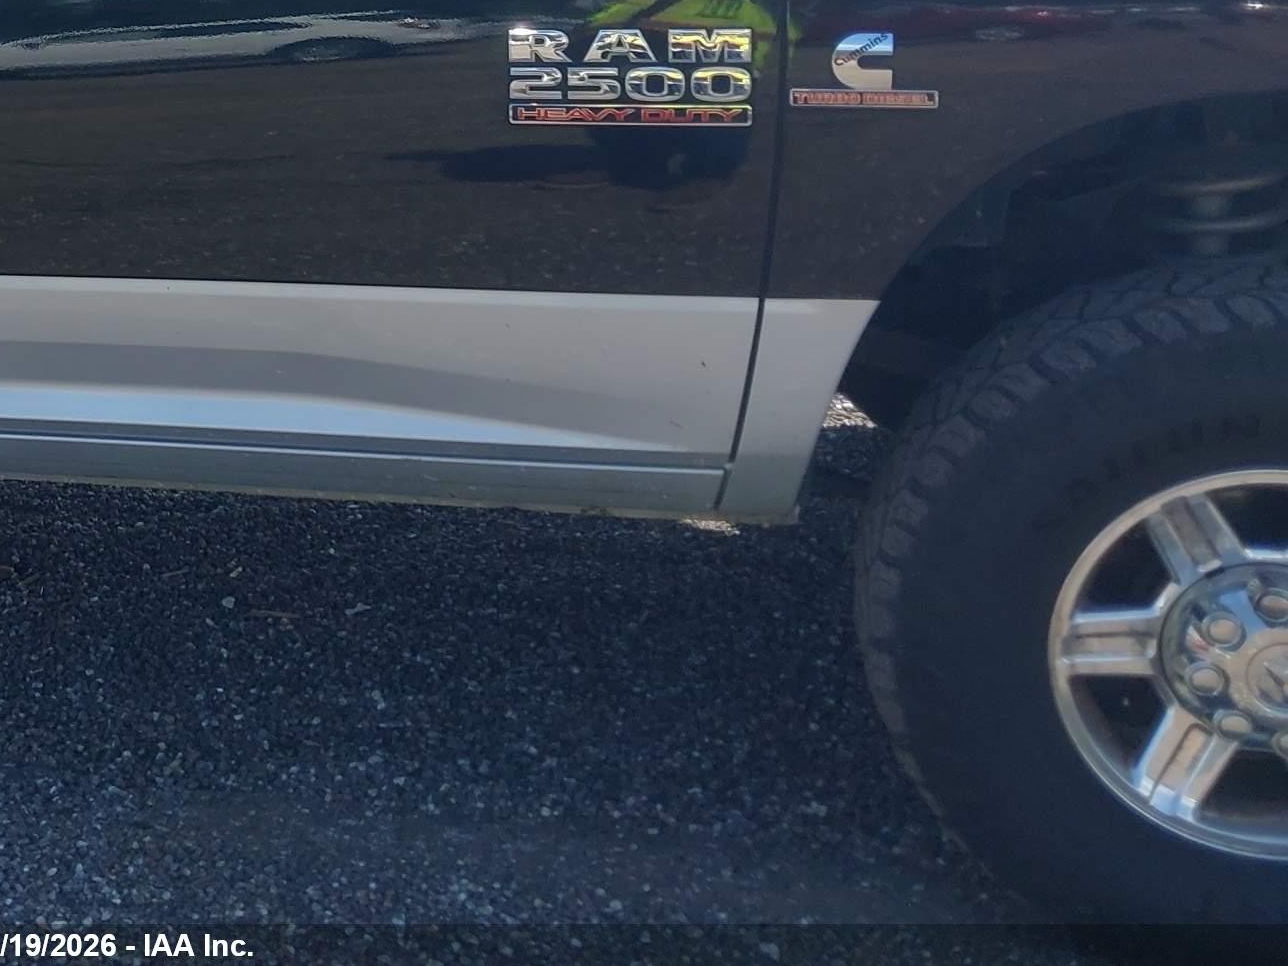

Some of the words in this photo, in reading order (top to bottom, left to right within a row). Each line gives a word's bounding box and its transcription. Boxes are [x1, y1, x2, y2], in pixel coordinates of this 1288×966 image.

[507, 28, 753, 63] RAM
[833, 32, 889, 67] Cummins
[508, 66, 753, 103] 2500
[516, 106, 637, 122] HEAVY
[640, 108, 745, 123] DUTY
